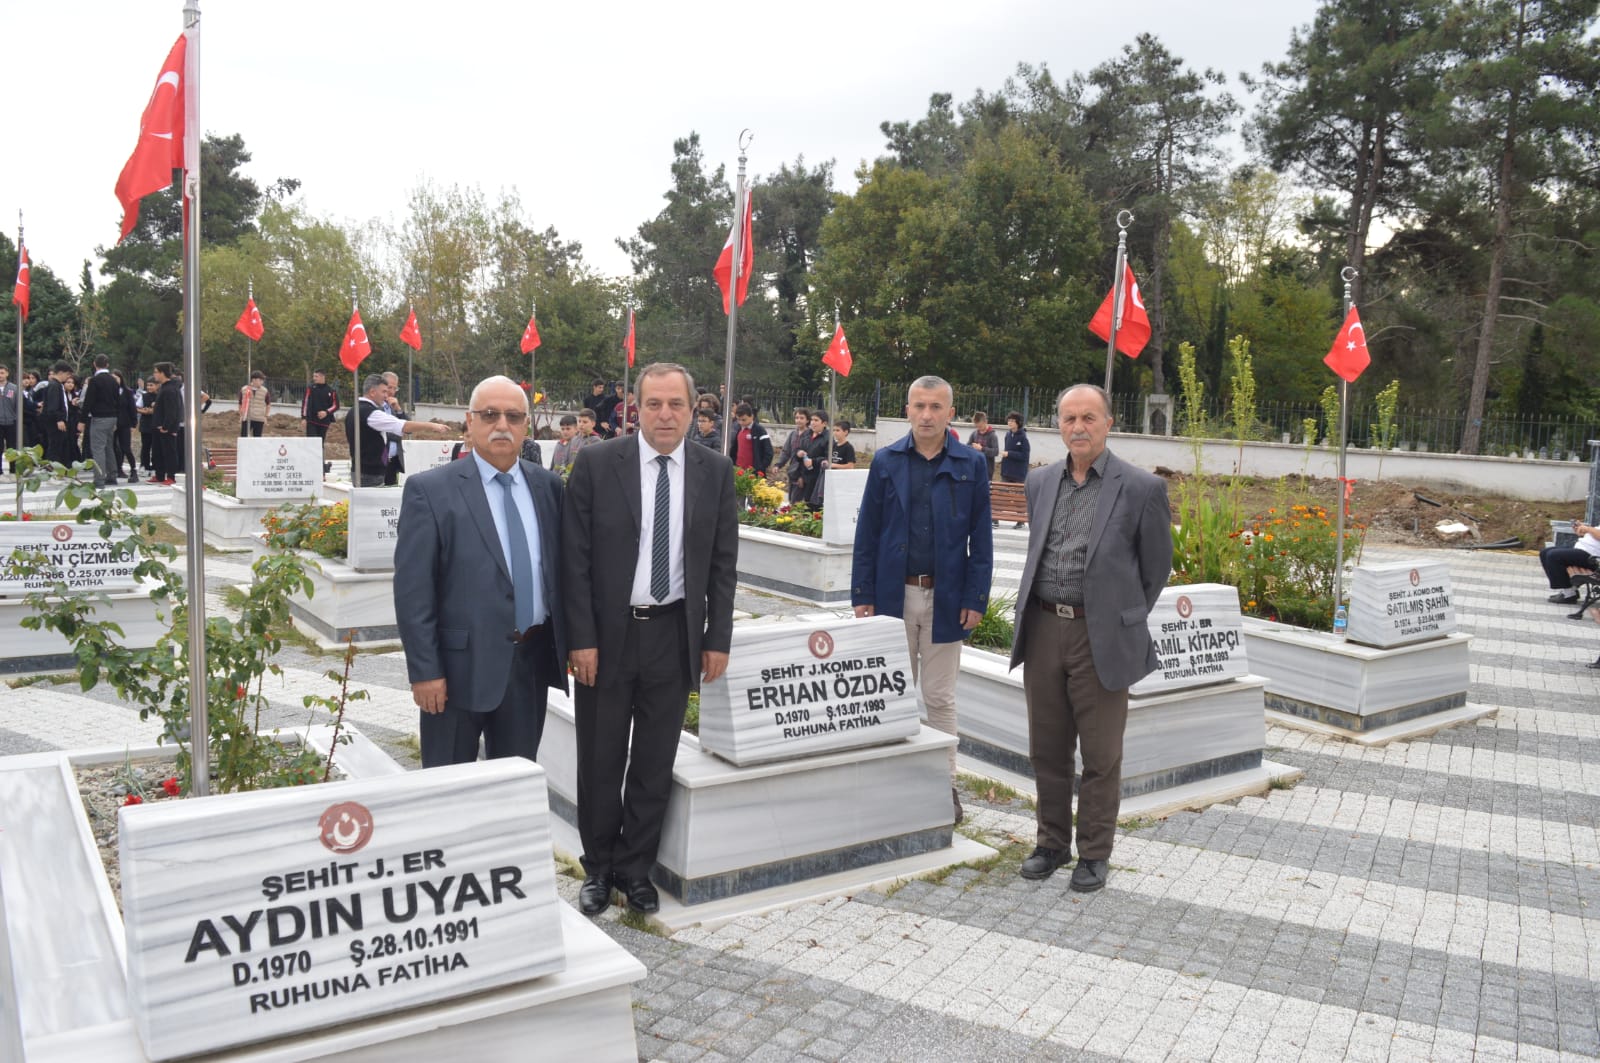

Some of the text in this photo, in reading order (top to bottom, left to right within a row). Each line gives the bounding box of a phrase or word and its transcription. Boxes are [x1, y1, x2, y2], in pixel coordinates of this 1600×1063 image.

[381, 508, 397, 517] ŞEHİT
[1387, 594, 1449, 615] SATILMIŞ ŞAHİN
[1389, 590, 1406, 601] ŞEHİT
[1162, 619, 1212, 634] ŞEHİT J. ER
[1401, 627, 1421, 635] RUHUNA
[1153, 630, 1239, 656] AMİL KİTAPÇI
[761, 657, 886, 683] ŞEHİT J.KOMD.ER
[1158, 658, 1179, 670] D.1973
[1164, 664, 1223, 680] RUHUNA FATİHA
[748, 671, 906, 710] ERHAN ÖZDAŞ
[776, 699, 885, 725] D.1970 Ş.13.07.1993
[784, 715, 880, 738] RUHUNA FATİHA
[262, 849, 446, 901] ŞEHİT J. ER
[185, 866, 526, 962] AYDIN UYAR
[233, 918, 479, 986] D.1970 Ş.28.10.1991
[251, 951, 468, 1013] RUHUNA FATİHA
